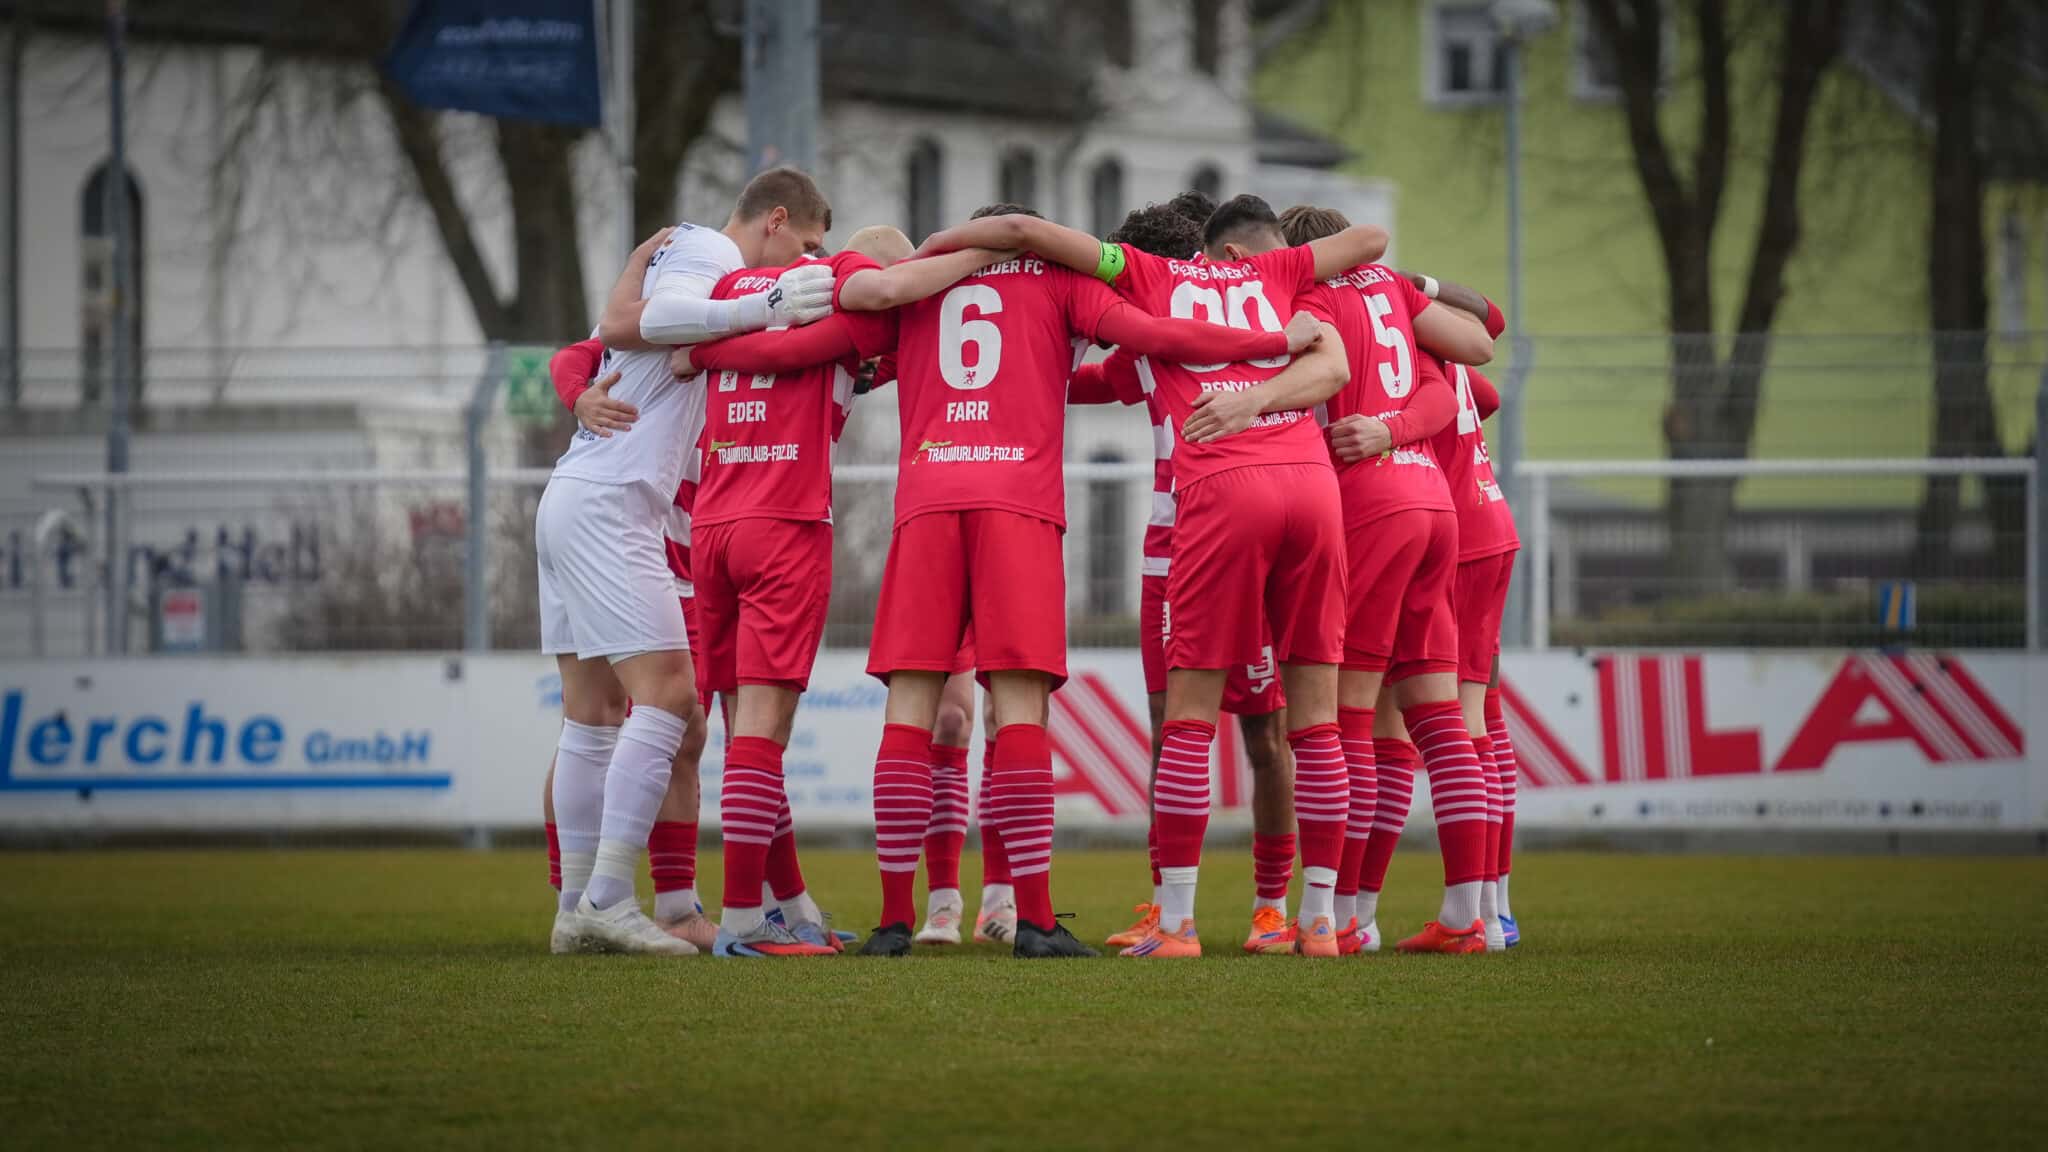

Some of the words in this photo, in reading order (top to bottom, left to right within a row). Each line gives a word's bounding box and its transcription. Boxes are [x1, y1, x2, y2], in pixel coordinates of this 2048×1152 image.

[1024, 259, 1044, 275] FC
[938, 284, 1003, 390] 6
[1362, 293, 1413, 399] 5
[727, 400, 767, 424] EDER
[946, 400, 989, 423] FARR
[927, 445, 1025, 463] TRAUMURLAUB-FDZ.DE
[0, 689, 284, 782] Lerche
[304, 729, 431, 764] GmbH
